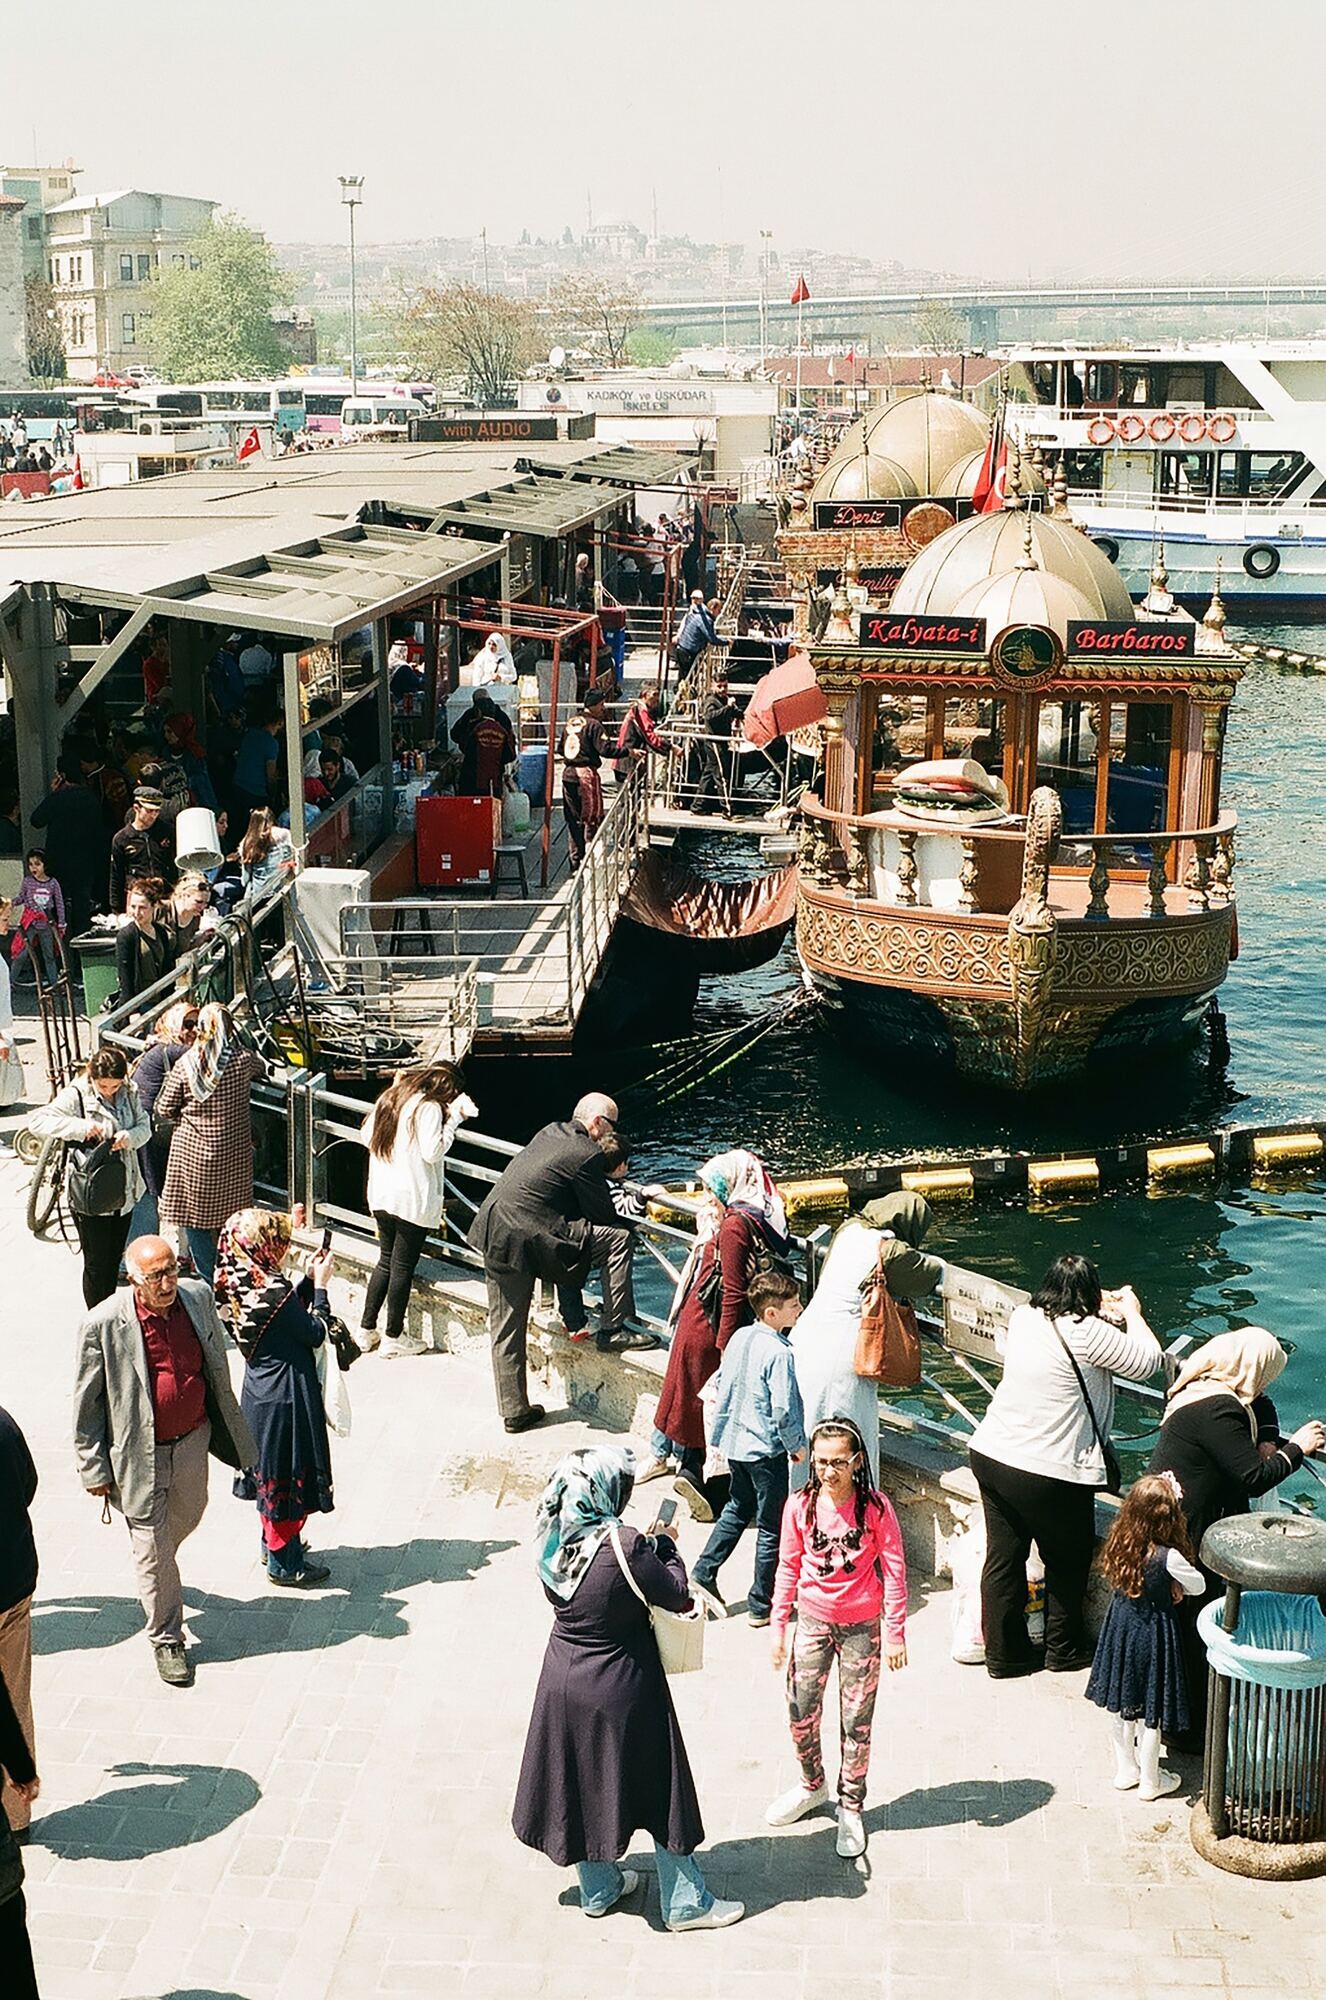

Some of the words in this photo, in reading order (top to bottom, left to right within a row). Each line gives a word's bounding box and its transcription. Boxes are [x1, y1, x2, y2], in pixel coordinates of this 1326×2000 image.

[656, 389, 707, 401] ÜSKÜDAR
[443, 423, 473, 437] with
[477, 422, 531, 436] AUDIO
[833, 506, 885, 526] Deniz
[868, 618, 979, 645] Kalyata-i
[1075, 627, 1187, 650] Barbaros
[968, 1325, 996, 1342] YASAK
